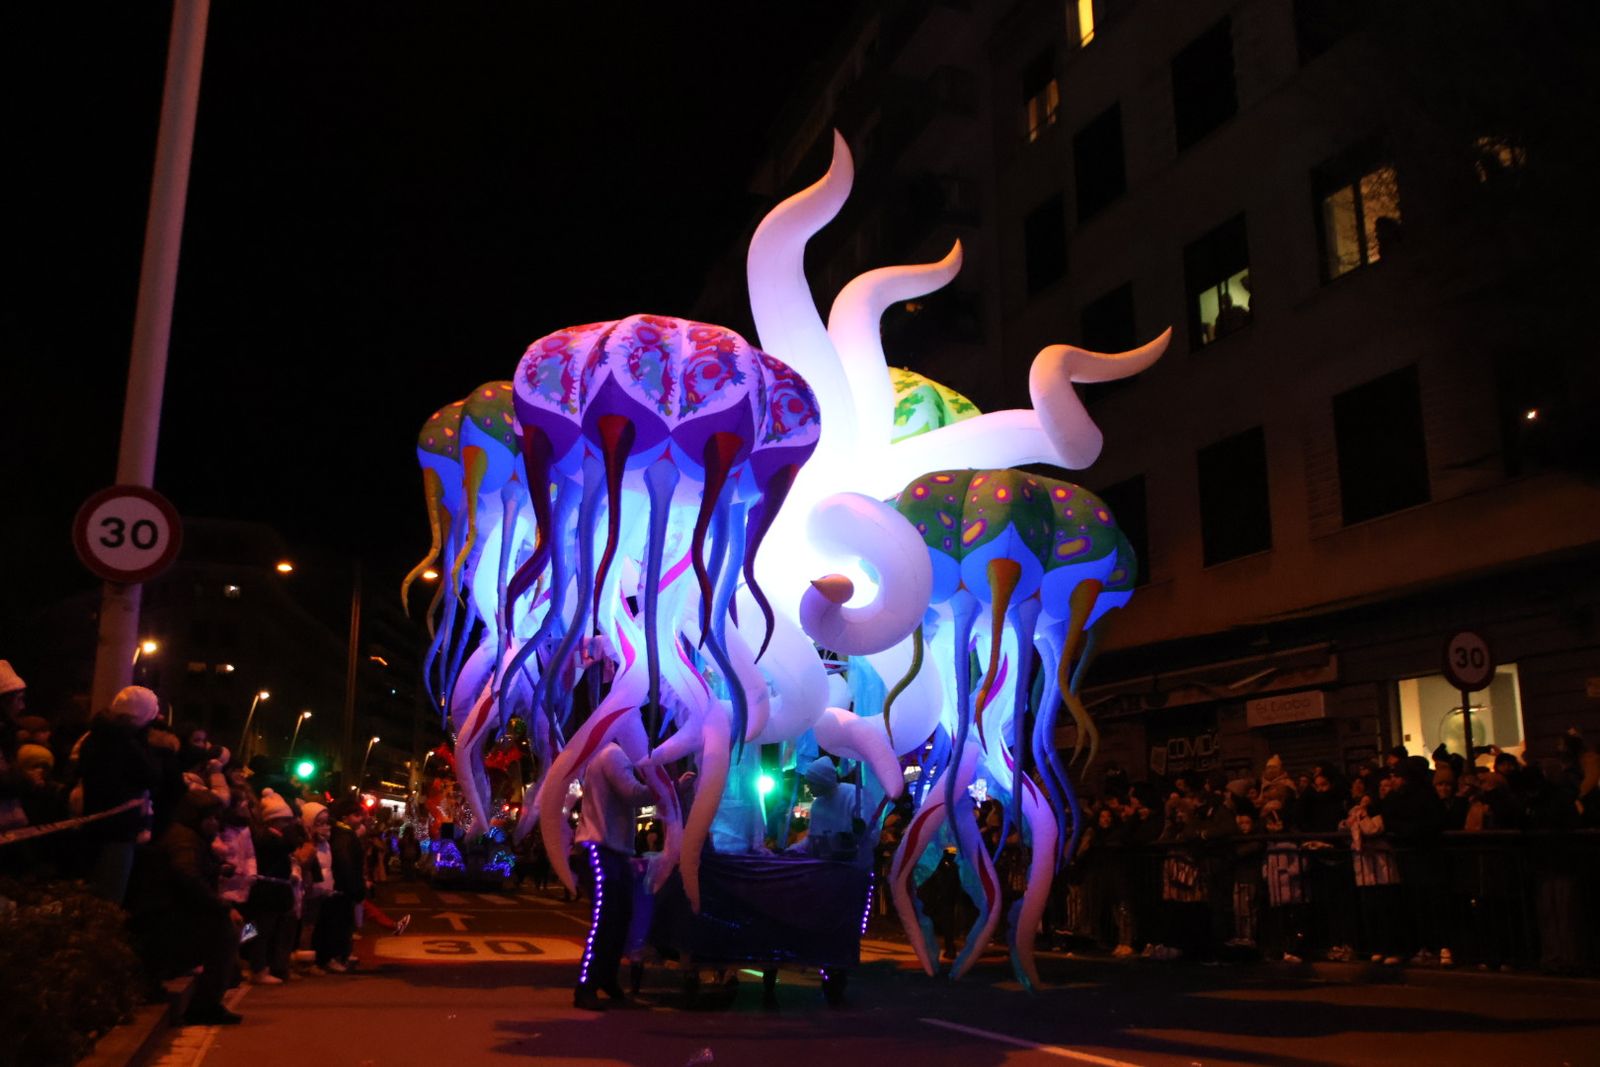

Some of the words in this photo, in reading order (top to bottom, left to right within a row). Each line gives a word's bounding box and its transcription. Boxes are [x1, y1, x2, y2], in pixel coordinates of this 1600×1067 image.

[100, 517, 159, 550] 30
[1455, 646, 1485, 669] 30
[422, 939, 546, 955] 30
